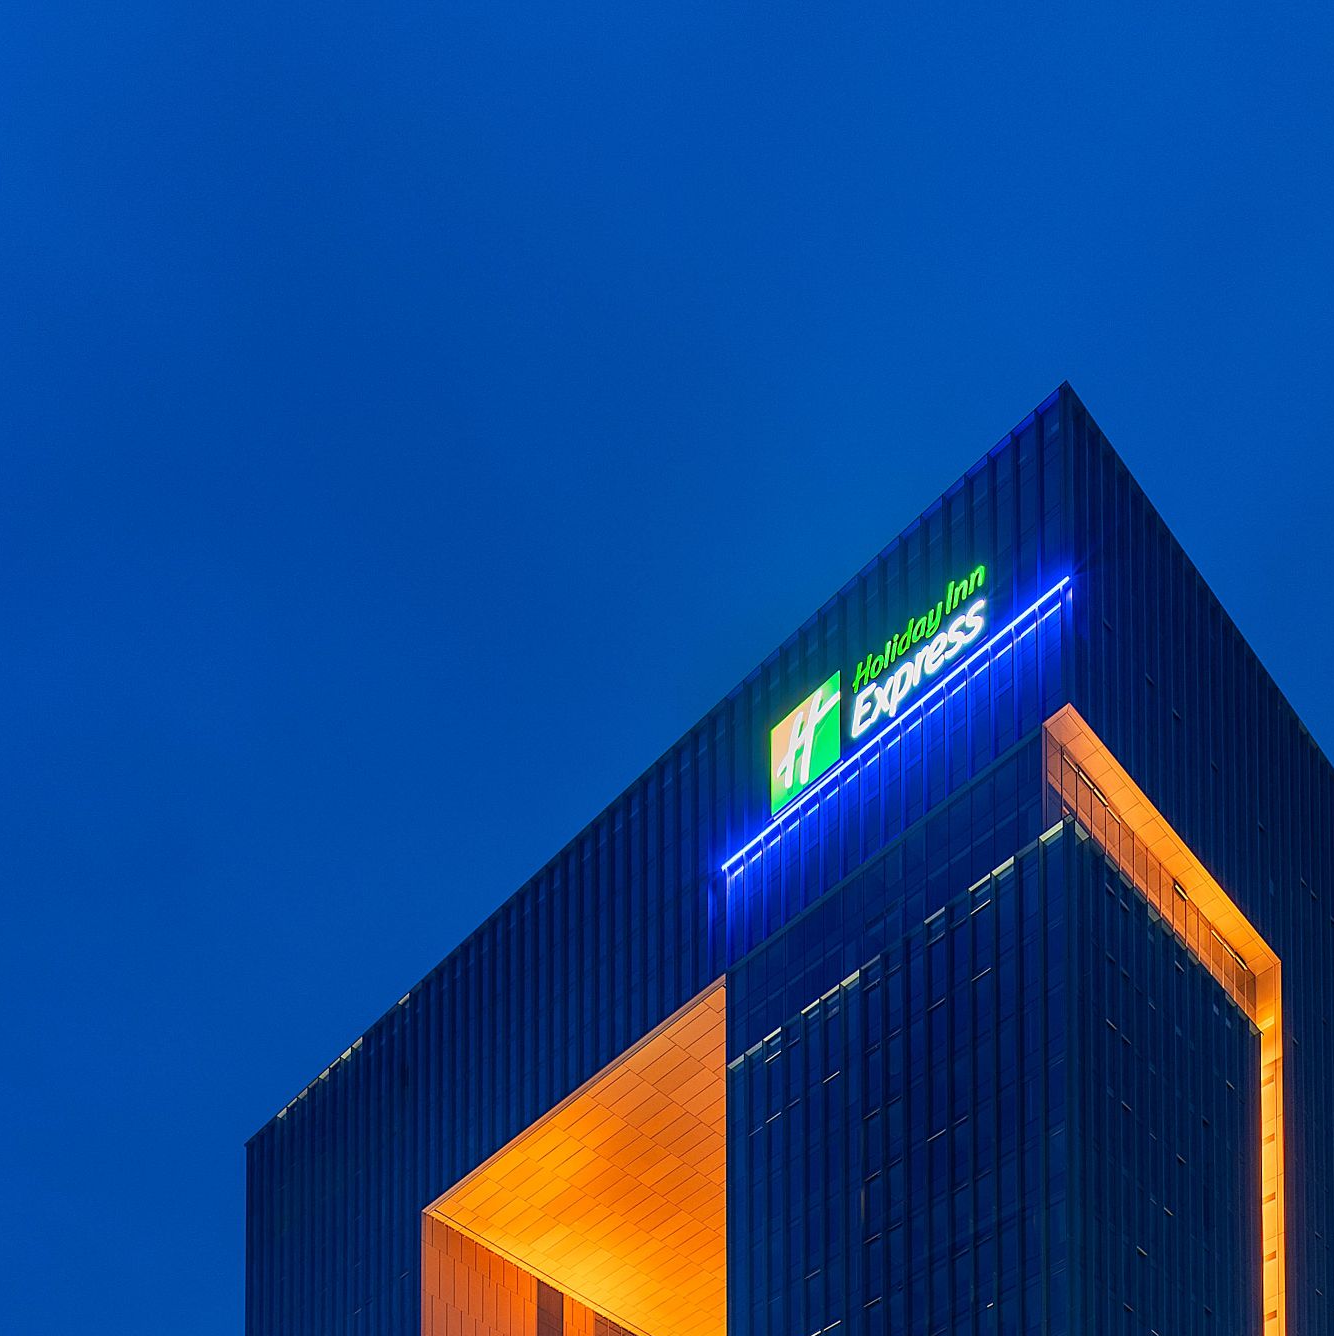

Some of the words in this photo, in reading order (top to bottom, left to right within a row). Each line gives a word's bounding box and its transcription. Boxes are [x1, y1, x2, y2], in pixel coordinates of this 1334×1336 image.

[851, 598, 986, 738] Express
[852, 601, 943, 693] Holiday
[945, 564, 986, 615] Inn
